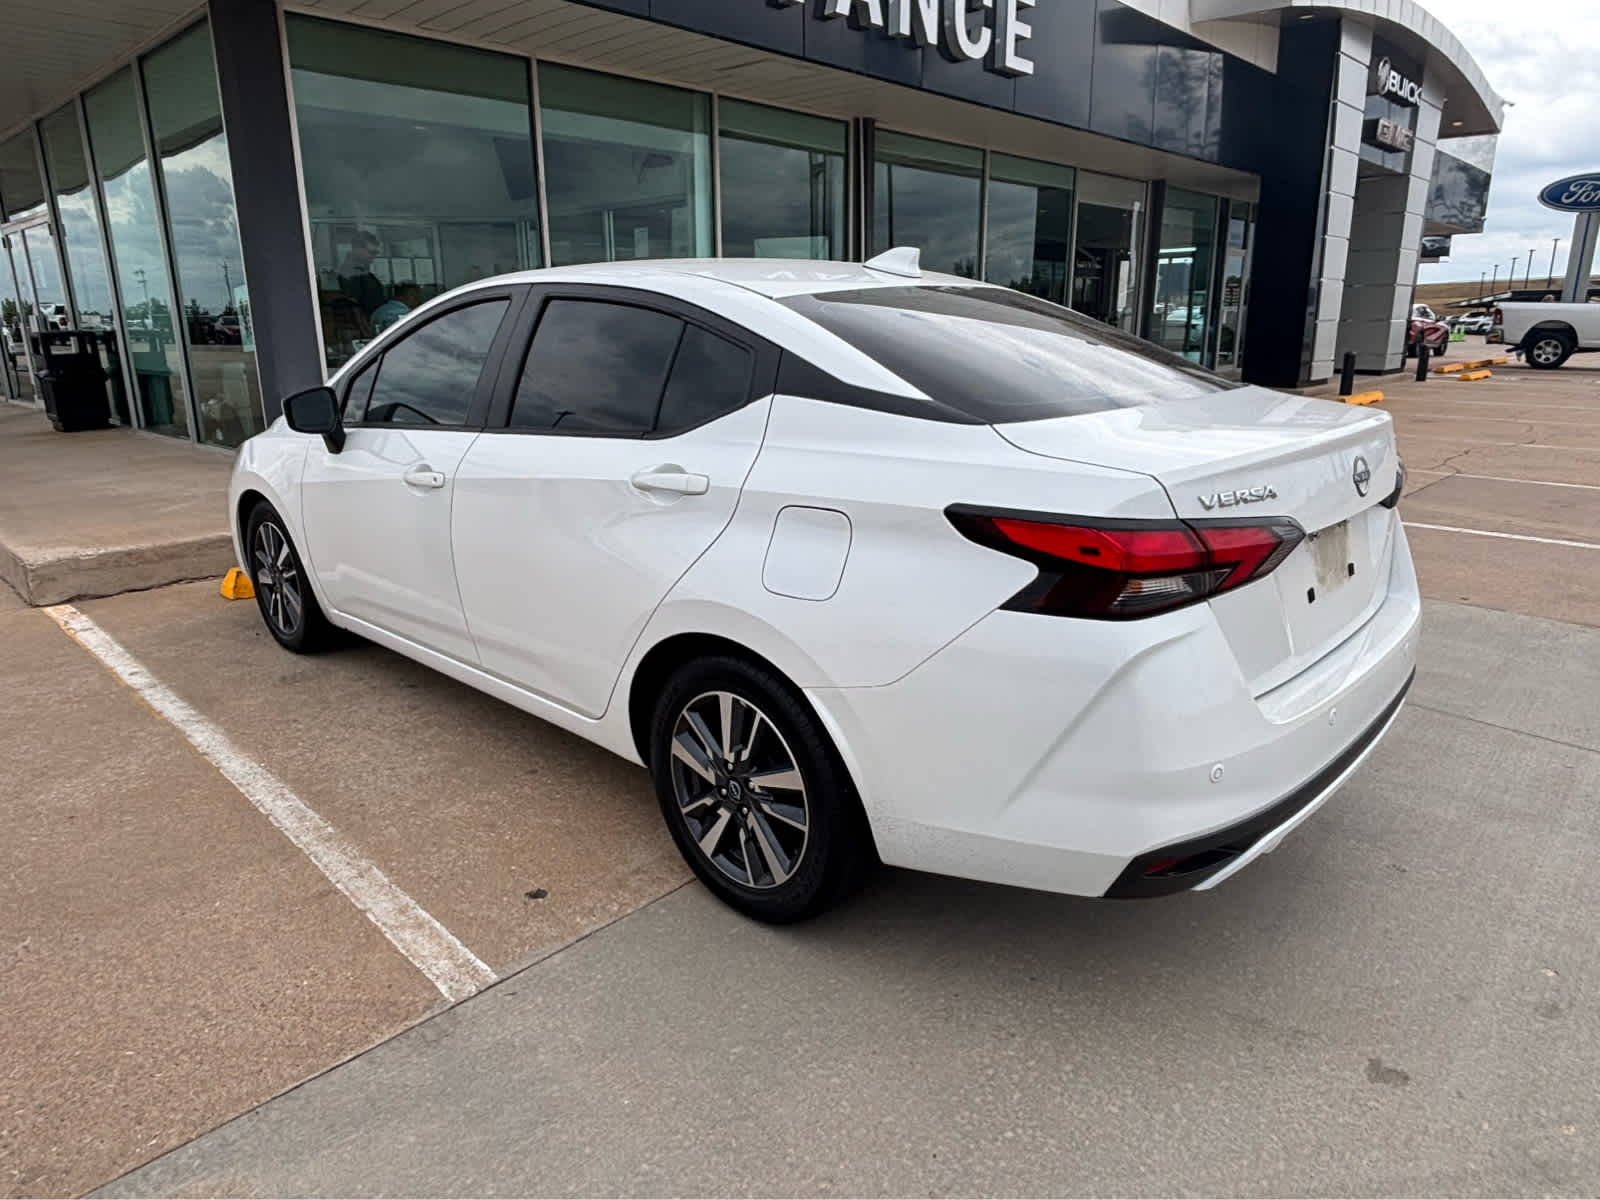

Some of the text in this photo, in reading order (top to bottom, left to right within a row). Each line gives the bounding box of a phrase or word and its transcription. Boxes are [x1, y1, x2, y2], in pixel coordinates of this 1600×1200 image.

[783, 0, 1034, 75] NCE
[1388, 69, 1422, 106] BUICK
[1561, 180, 1600, 204] For
[1197, 485, 1277, 511] VERSA
